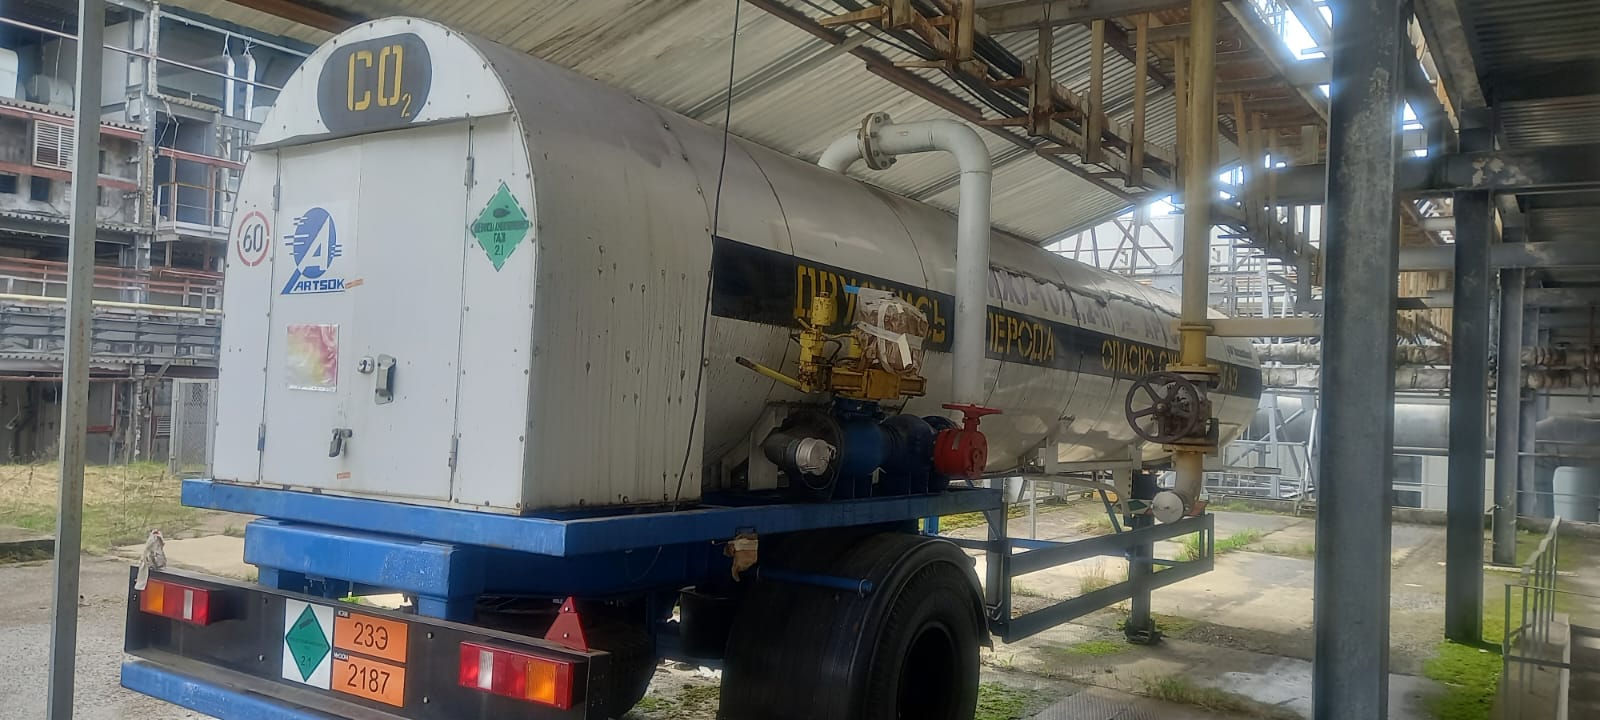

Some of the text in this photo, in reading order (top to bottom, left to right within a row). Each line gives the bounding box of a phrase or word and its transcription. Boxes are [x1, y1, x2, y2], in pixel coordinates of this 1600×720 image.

[242, 223, 264, 253] 60
[293, 279, 345, 292] ARTSOK
[794, 264, 946, 344] ДВУСЬ
[1102, 339, 1155, 376] ОПАСНО
[347, 663, 391, 695] 2187
